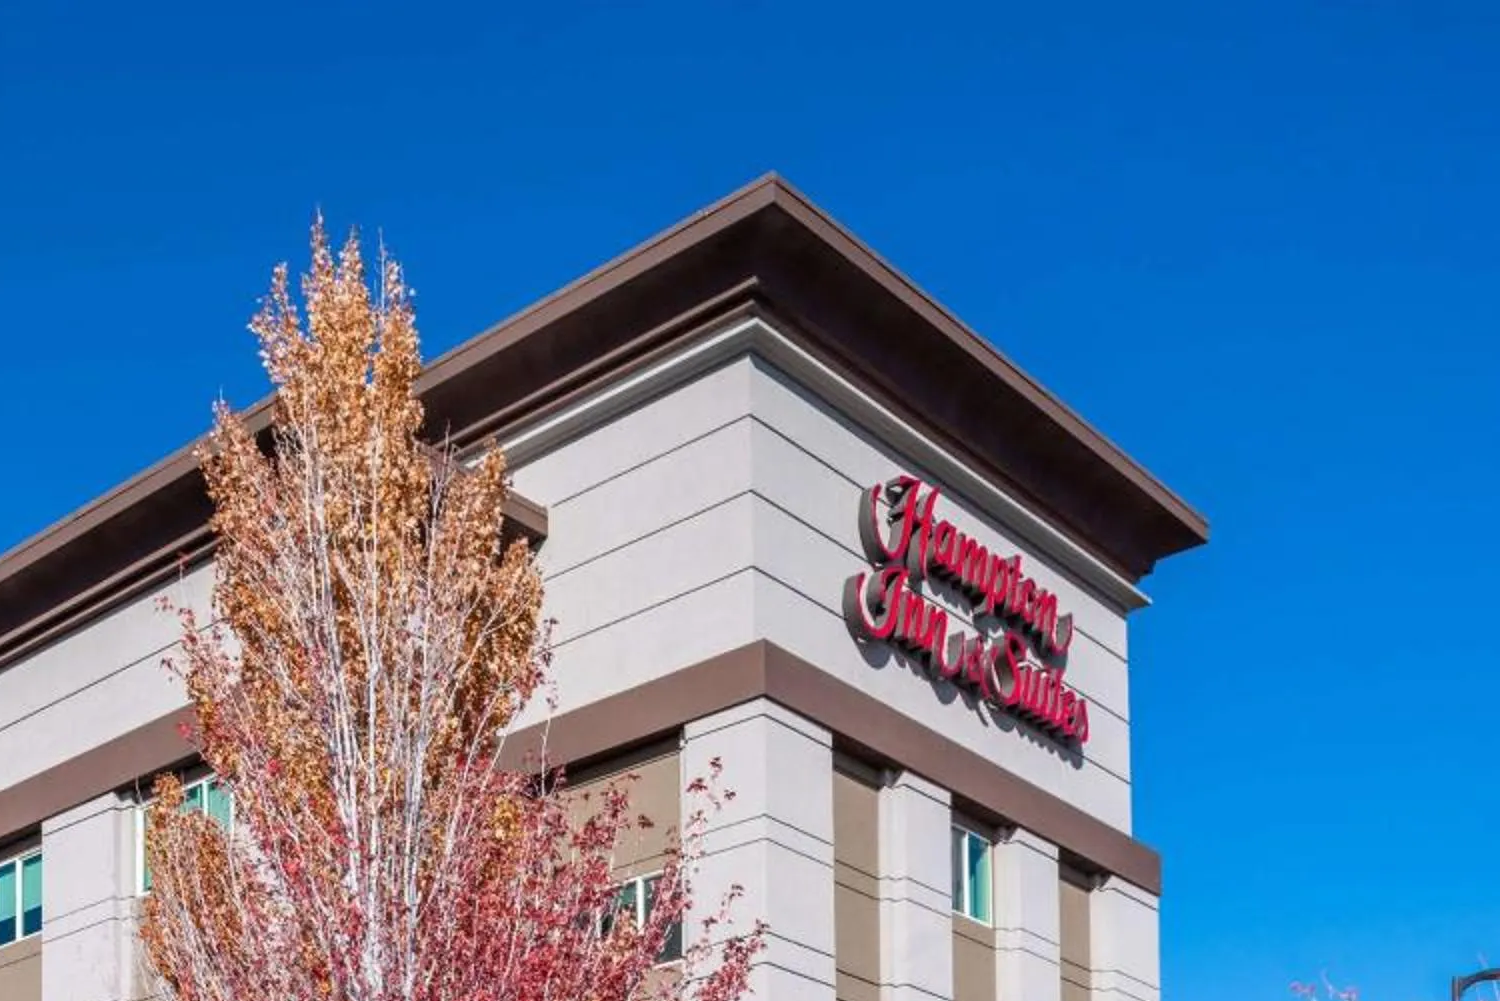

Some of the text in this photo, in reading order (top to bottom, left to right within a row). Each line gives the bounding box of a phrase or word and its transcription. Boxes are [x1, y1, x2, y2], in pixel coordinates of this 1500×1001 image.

[849, 566, 965, 676] Inn
[988, 630, 1090, 744] Suites
[865, 475, 1073, 656] Hampton
